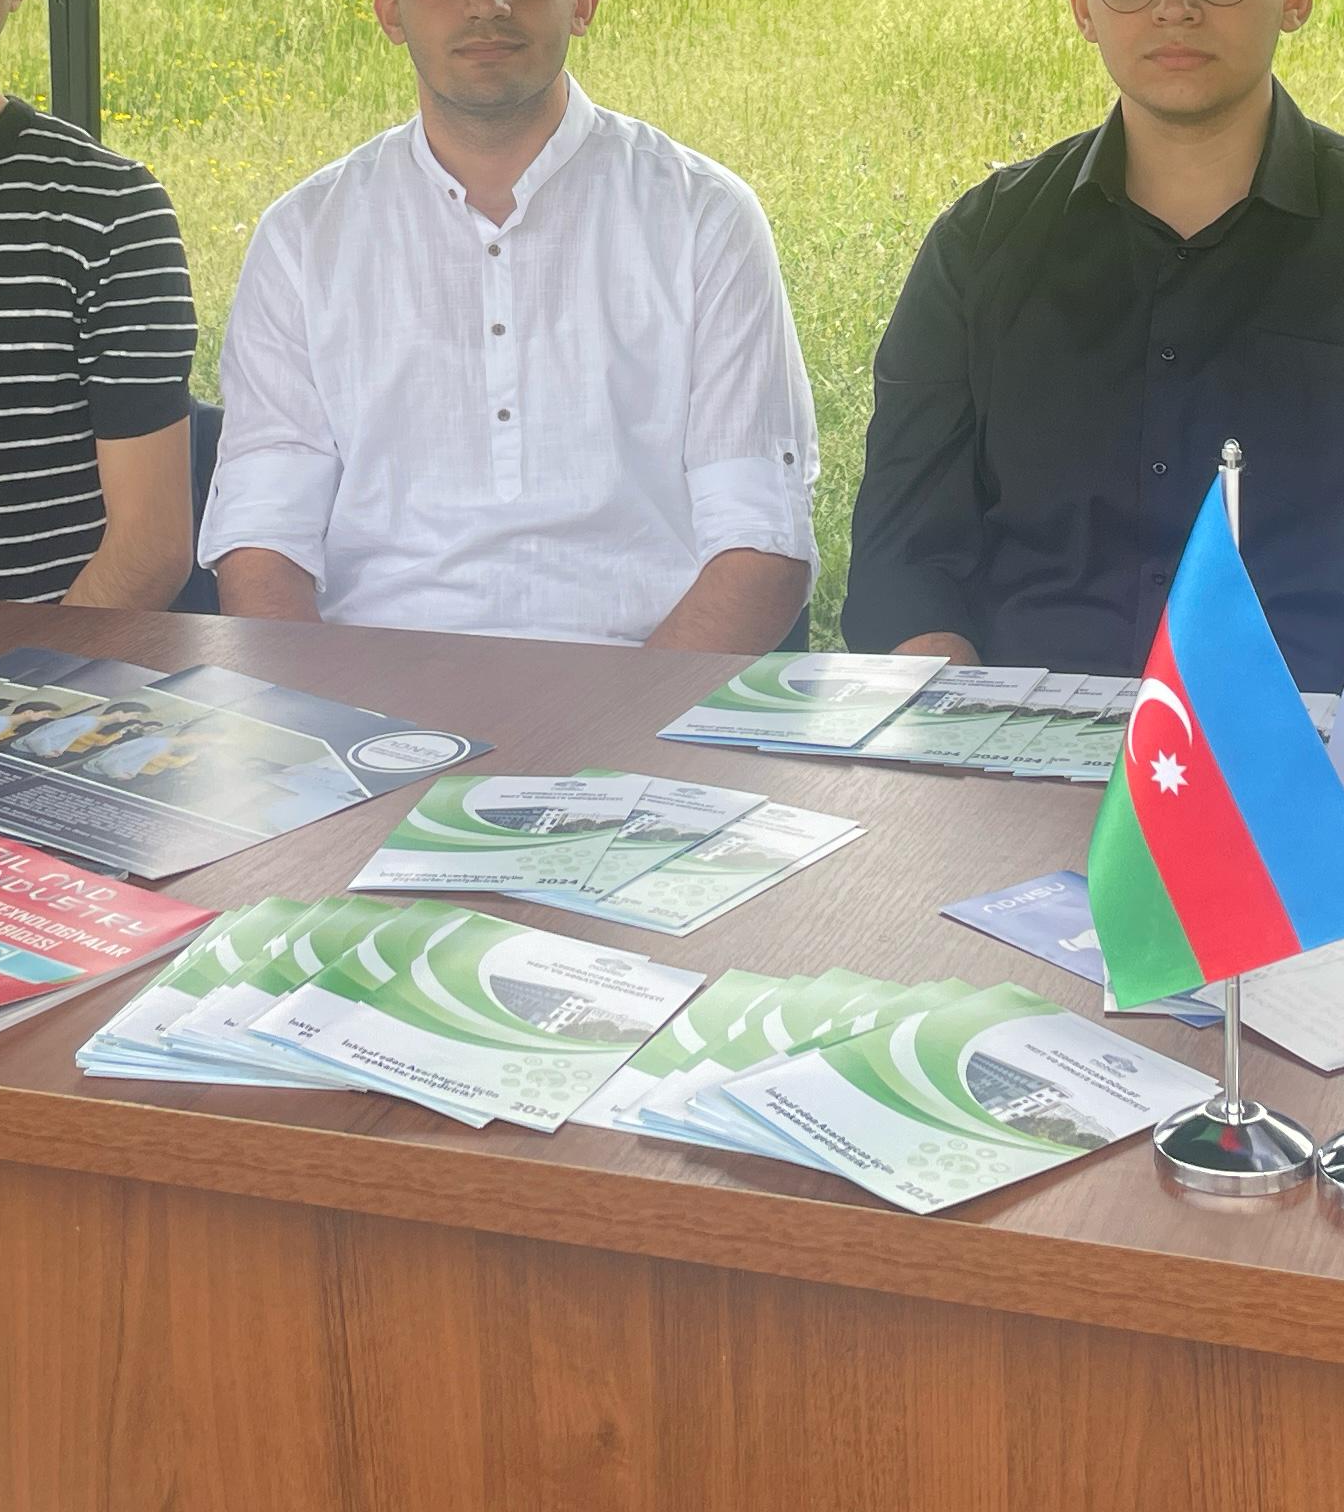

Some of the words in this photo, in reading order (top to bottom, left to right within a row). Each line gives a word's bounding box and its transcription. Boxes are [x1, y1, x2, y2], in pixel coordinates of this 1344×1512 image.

[38, 872, 118, 901] AND
[509, 1101, 560, 1121] 2024
[896, 1181, 944, 1205] 2024
